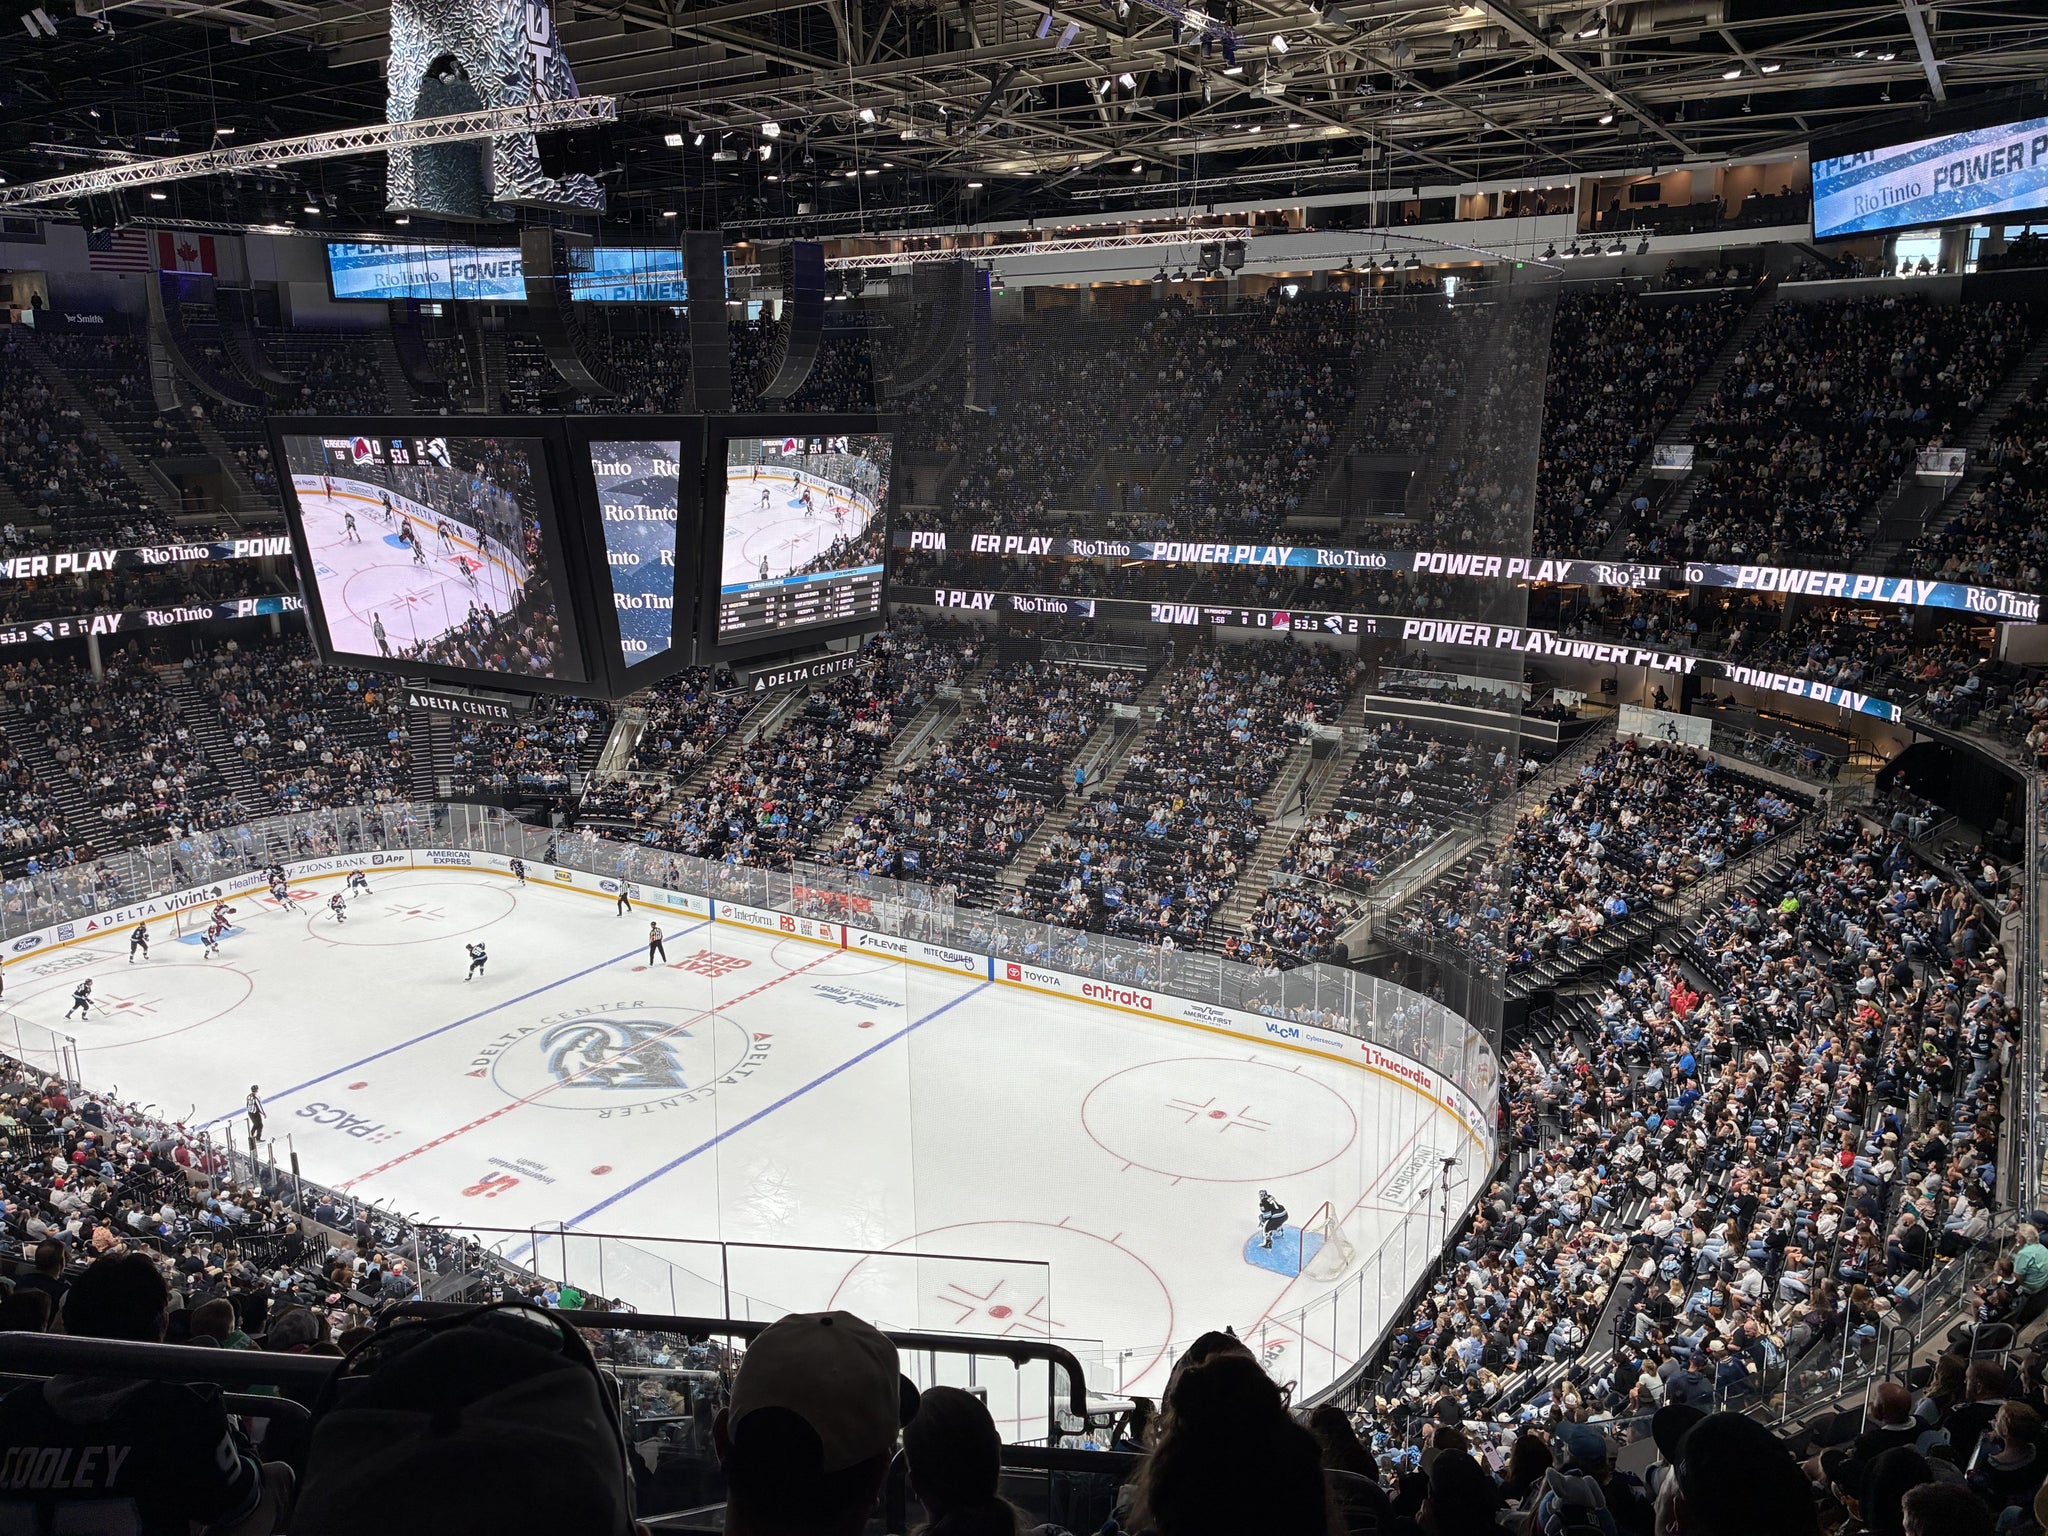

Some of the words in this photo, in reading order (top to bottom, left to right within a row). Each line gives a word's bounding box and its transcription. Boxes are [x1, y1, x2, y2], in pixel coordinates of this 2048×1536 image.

[1933, 142, 2024, 196] POWER
[415, 440, 425, 456] 2
[1005, 536, 1053, 555] PLAY
[1153, 542, 1230, 563] POWER
[1235, 545, 1294, 566] PLAY
[55, 550, 118, 574] PLAY
[1412, 552, 1502, 577] POWER
[1507, 558, 1573, 582] PLAY
[1736, 566, 1847, 598] POWER
[1852, 575, 1938, 606] PLAY
[949, 591, 995, 610] PLAY
[59, 622, 70, 636] 2
[1257, 613, 1267, 627] 0
[1294, 619, 1318, 631] 53.3
[1348, 620, 1358, 633] 2
[1402, 620, 1491, 647] POWER
[1495, 628, 1557, 654] PLAY
[769, 668, 808, 687] DELTA
[812, 658, 854, 677] CENTER
[420, 696, 460, 712] DELTA
[462, 702, 509, 719] CENTER
[299, 862, 333, 874] ZIONS
[336, 857, 367, 869] BANK
[427, 850, 470, 859] AMERICAN
[434, 857, 471, 866] EXPRESS
[104, 904, 157, 926] DELTA
[868, 937, 908, 953] FILEVINE
[1024, 971, 1061, 986] TOYOTA
[1082, 983, 1152, 1010] entrata
[1183, 1010, 1212, 1022] AMERICA
[1212, 1016, 1232, 1025] FIRST
[471, 1026, 535, 1067] DELTA
[540, 1000, 646, 1025] CENTER
[1305, 1033, 1344, 1049] Cybersecurity
[718, 1042, 771, 1086] DELTA
[1373, 1050, 1432, 1090] Trucordia
[599, 1087, 716, 1119] CENTER
[295, 1102, 386, 1138] PACS
